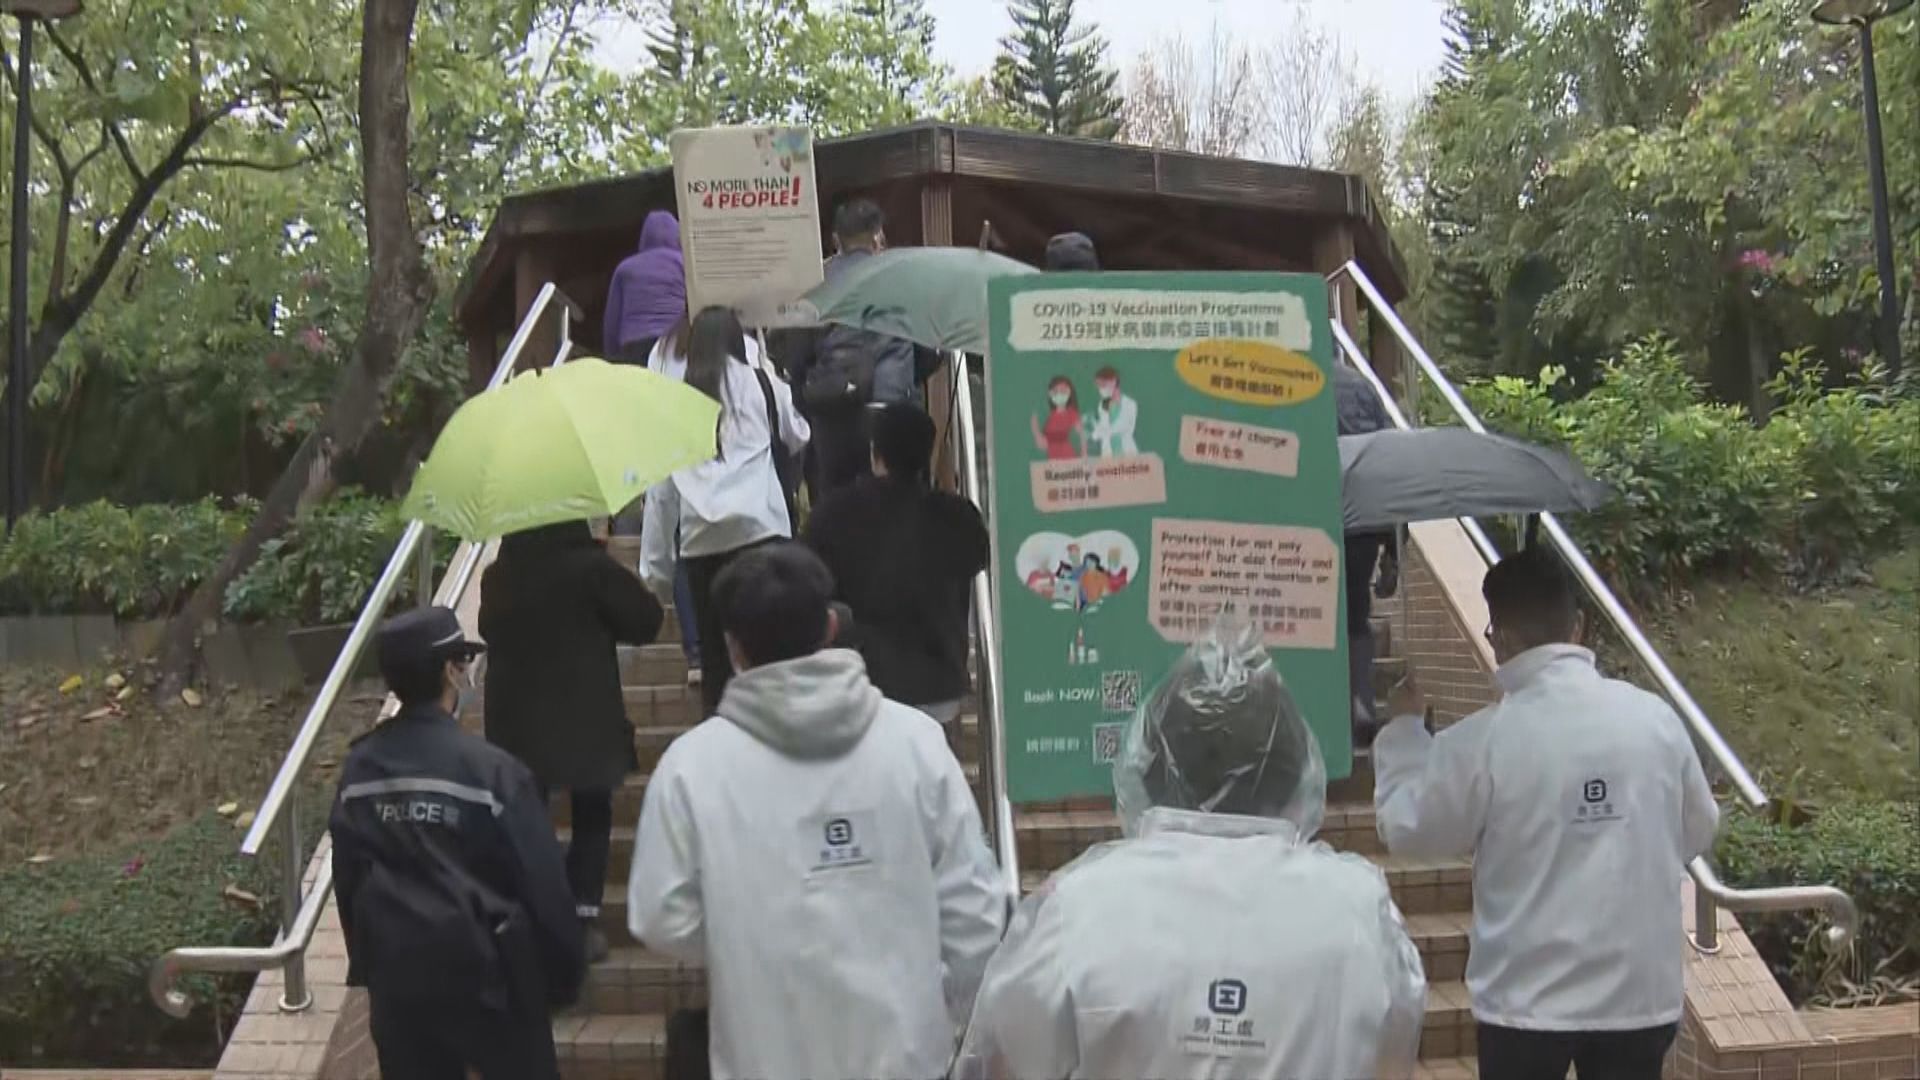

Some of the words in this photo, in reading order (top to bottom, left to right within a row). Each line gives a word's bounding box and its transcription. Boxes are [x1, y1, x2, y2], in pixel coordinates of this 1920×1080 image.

[711, 179, 749, 192] MORE
[753, 175, 790, 190] THAN
[702, 193, 713, 209] 4
[1033, 302, 1106, 318] COVID-19
[1112, 301, 1198, 316] Vaccination
[1201, 301, 1285, 317] Programme
[1229, 428, 1243, 441] of
[1096, 462, 1150, 478] available
[1161, 530, 1225, 546] Protection
[1231, 535, 1249, 547] for
[1254, 538, 1273, 549] not
[1278, 541, 1302, 553] only
[1161, 549, 1212, 562] yourself
[1217, 552, 1237, 564] but
[1243, 553, 1267, 566] also
[1271, 554, 1307, 569] family
[1312, 558, 1334, 570] and
[1161, 564, 1205, 578] friends
[1211, 569, 1241, 580] when
[1159, 579, 1192, 593] after
[1198, 582, 1250, 596] contract
[1254, 586, 1282, 598] ends
[1024, 687, 1055, 703] Book
[382, 801, 442, 824] POLICE
